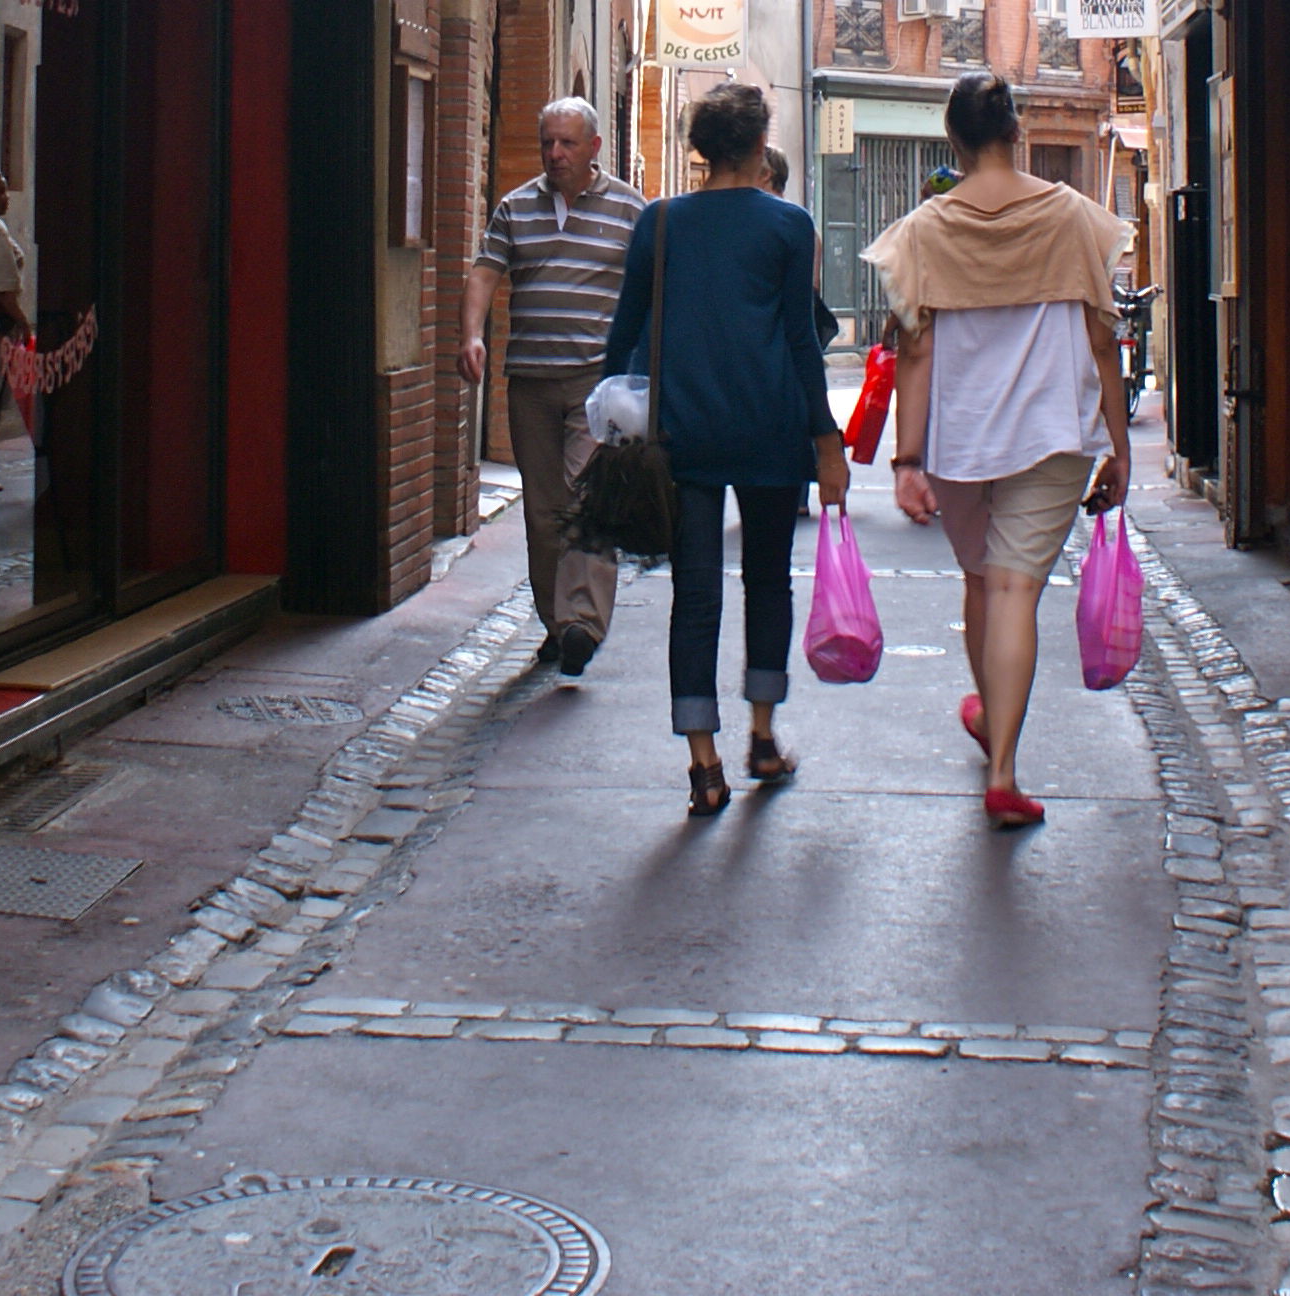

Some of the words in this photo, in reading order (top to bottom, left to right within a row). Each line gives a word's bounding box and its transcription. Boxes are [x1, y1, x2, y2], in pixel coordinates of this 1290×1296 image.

[678, 7, 725, 20] NUIT
[663, 42, 690, 60] DES
[693, 42, 741, 63] GESTES
